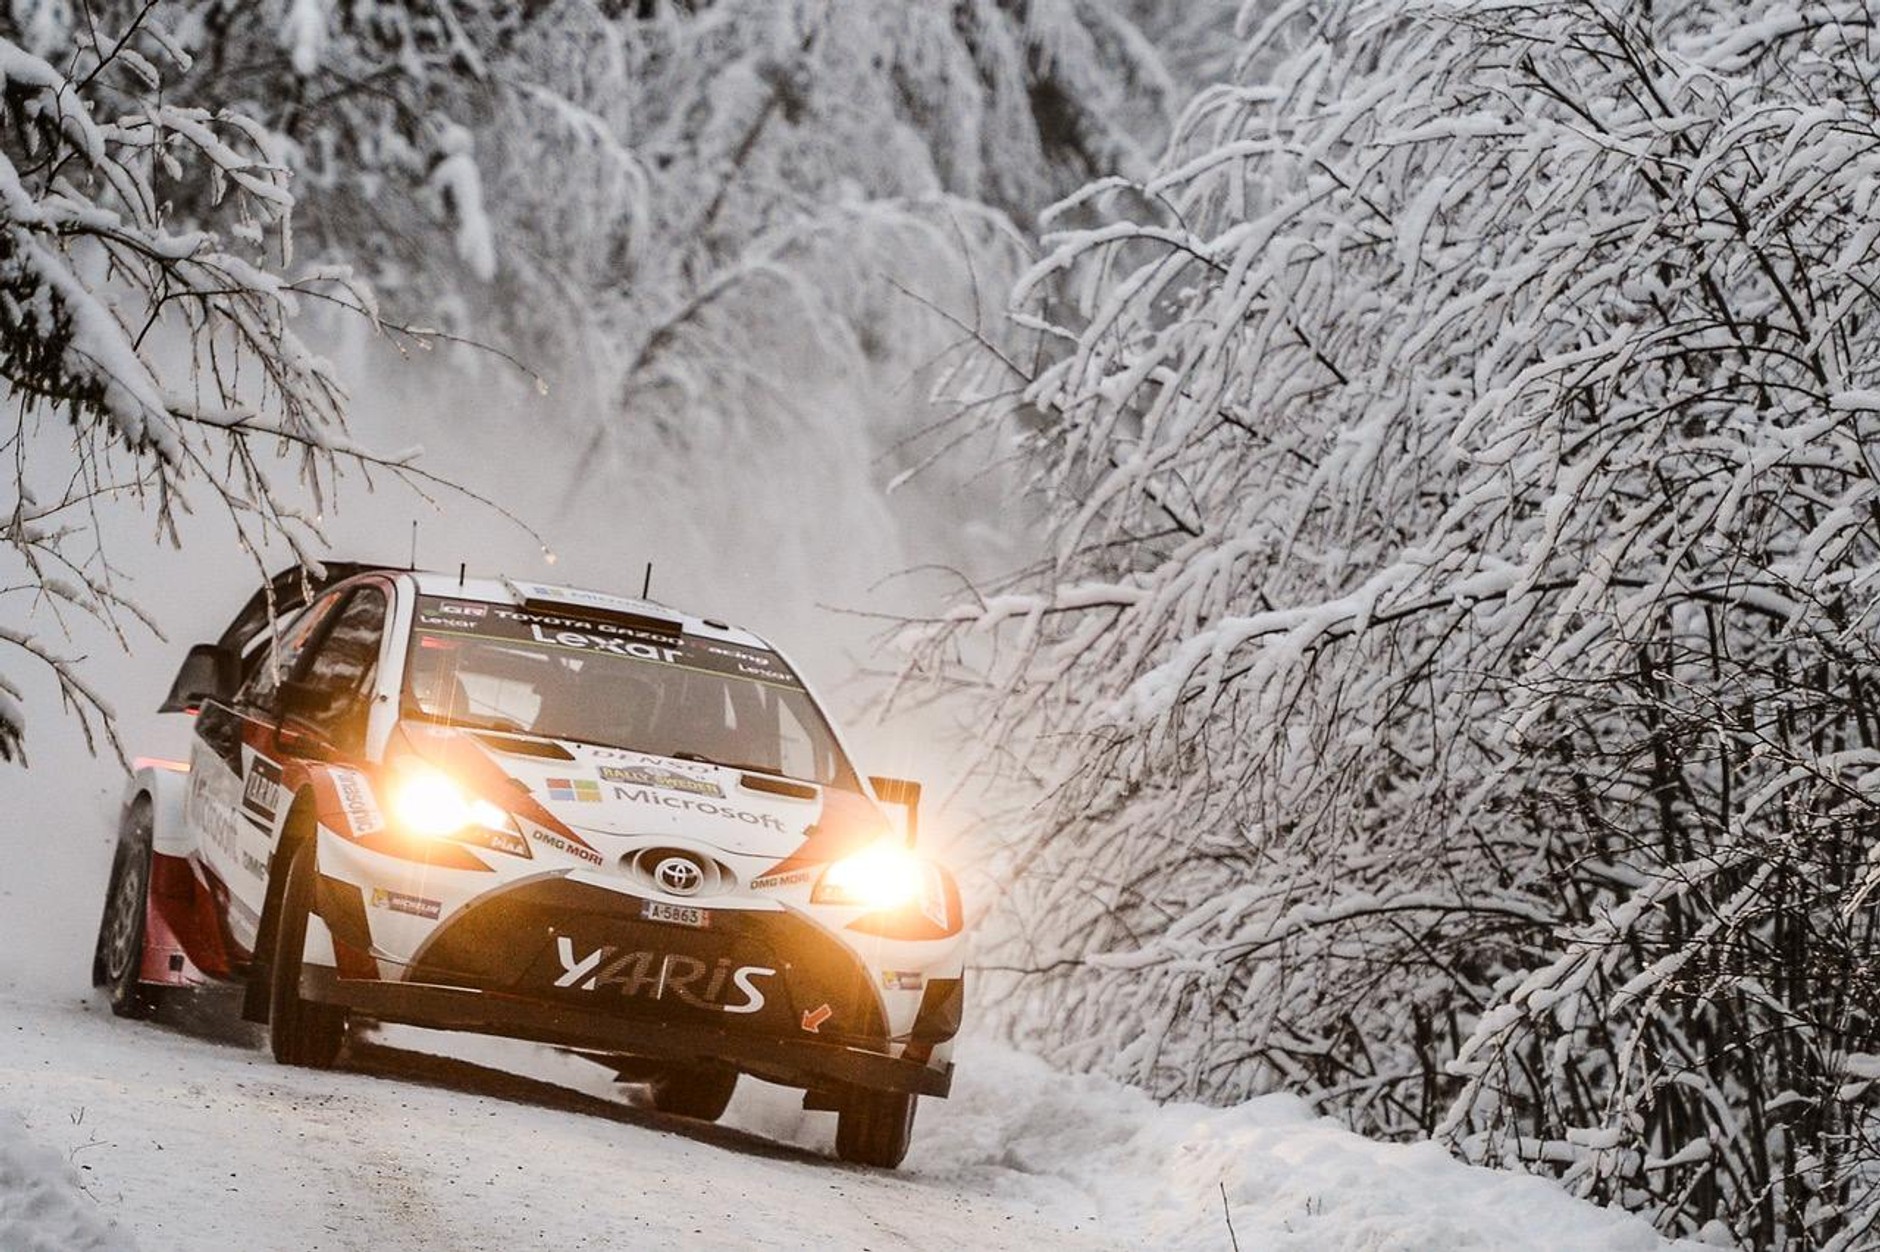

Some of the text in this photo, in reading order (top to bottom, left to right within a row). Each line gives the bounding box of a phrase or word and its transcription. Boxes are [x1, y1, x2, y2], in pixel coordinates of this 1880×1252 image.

[420, 614, 478, 629] Lexar
[494, 609, 592, 629] TOYOTA
[597, 624, 685, 646] GAZOO
[530, 622, 683, 663] Lexar
[738, 662, 794, 681] Lexar
[592, 749, 709, 774] DENSO
[602, 766, 720, 796] RALLY SWEDEN
[613, 786, 789, 834] Microsoft
[532, 829, 604, 866] DMG MORI
[751, 878, 777, 890] DMG
